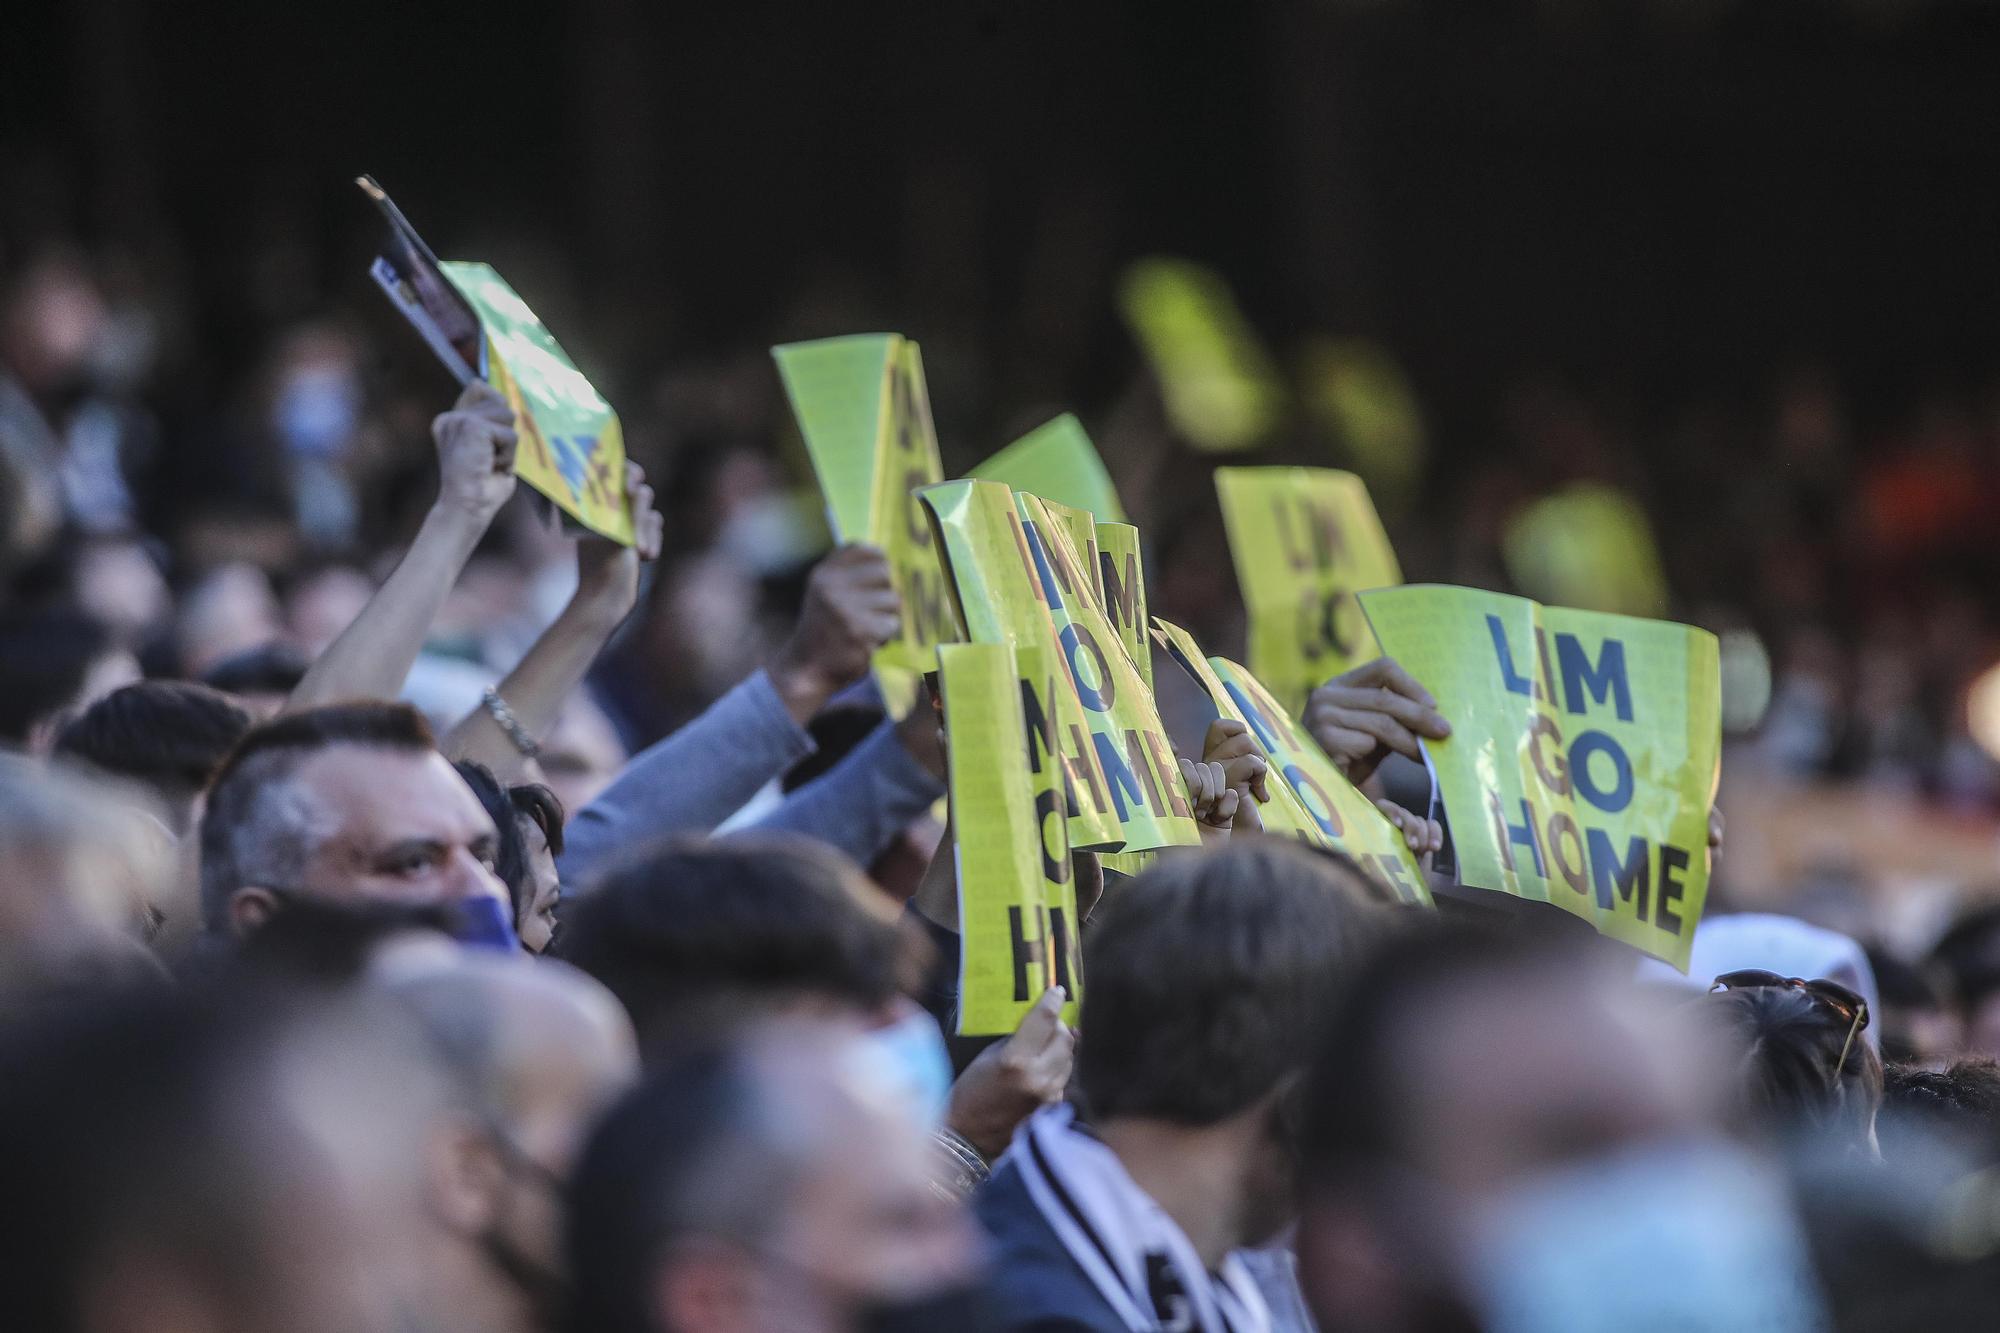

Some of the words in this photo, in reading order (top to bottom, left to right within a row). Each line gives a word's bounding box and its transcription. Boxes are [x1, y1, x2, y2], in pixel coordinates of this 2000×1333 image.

[1486, 614, 1634, 722] LIM
[1527, 713, 1634, 813] GO
[1489, 789, 1689, 936] HOME
